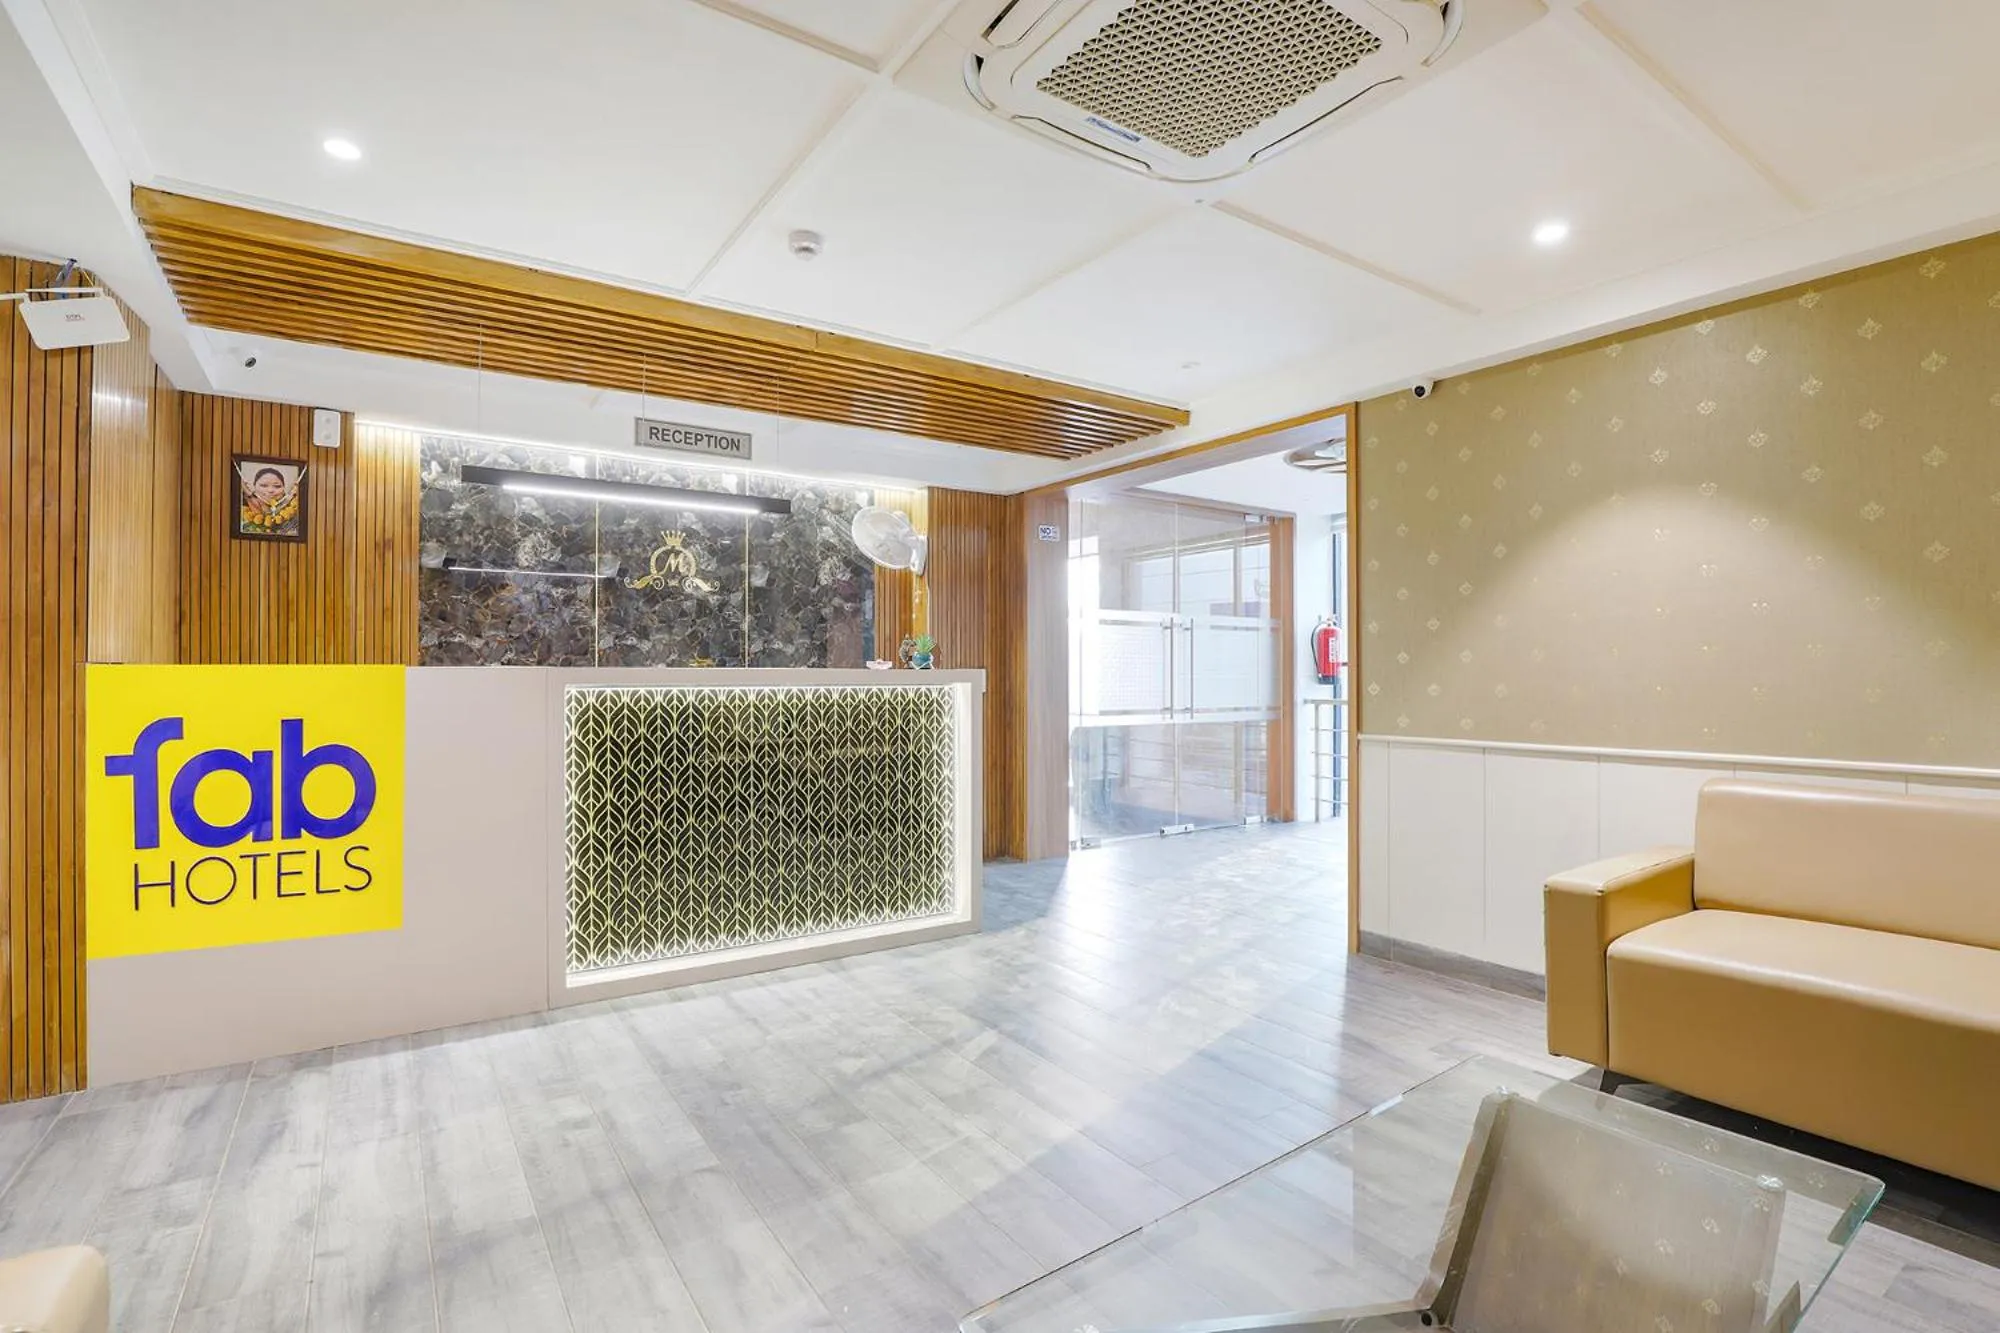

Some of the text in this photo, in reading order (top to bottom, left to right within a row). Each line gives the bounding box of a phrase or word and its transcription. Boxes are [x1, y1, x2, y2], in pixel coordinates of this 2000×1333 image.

[649, 426, 741, 451] RECEPTION
[105, 717, 376, 850] fab
[134, 845, 372, 911] HOTELS
